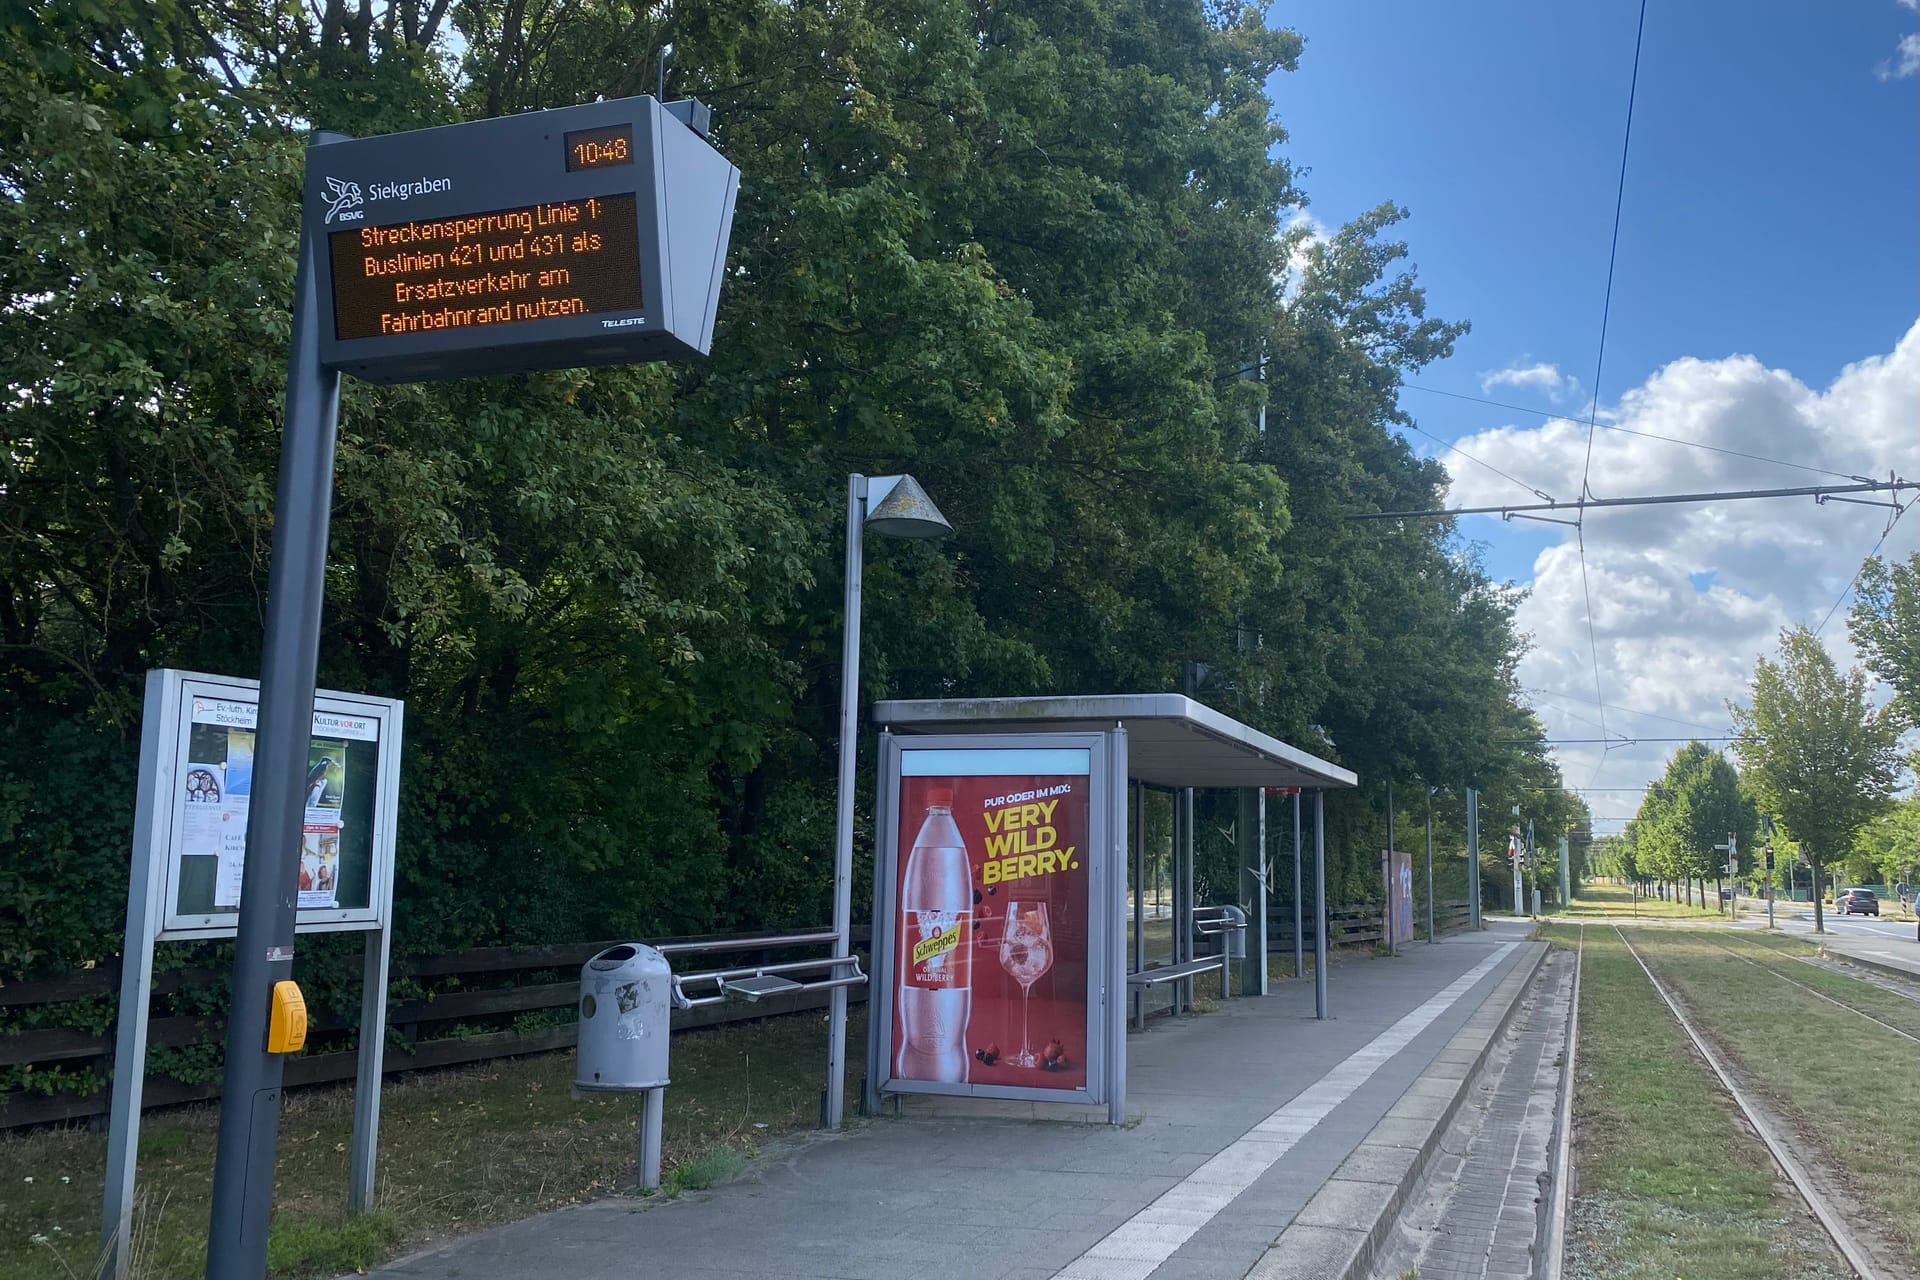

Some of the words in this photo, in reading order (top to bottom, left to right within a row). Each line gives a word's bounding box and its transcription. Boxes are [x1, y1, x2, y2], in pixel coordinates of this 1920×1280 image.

[574, 138, 627, 164] 10:48
[369, 177, 451, 201] Siekgraben
[339, 210, 364, 221] BSVG
[361, 212, 532, 247] Streckensperrung
[537, 202, 579, 225] Linie
[585, 198, 601, 219] 1:
[365, 250, 444, 276] Buslinien
[450, 243, 483, 266] 421
[489, 238, 524, 262] und
[530, 233, 564, 256] 431
[572, 231, 601, 252] als
[396, 270, 531, 302] Ersatzverkehr
[538, 269, 569, 286] am
[381, 300, 511, 333] Fahrbahnrand
[517, 297, 590, 320] nutzen.
[601, 317, 646, 328] TELESTE
[984, 796, 1005, 808] PUR
[1006, 790, 1035, 803] ODER
[1036, 788, 1048, 798] IM
[1049, 783, 1071, 796] MIX:
[983, 799, 1059, 834] VERY
[984, 826, 1057, 859] WILD
[983, 846, 1079, 885] BERRY.
[915, 932, 957, 960] Schweppes
[915, 973, 933, 982] WILD
